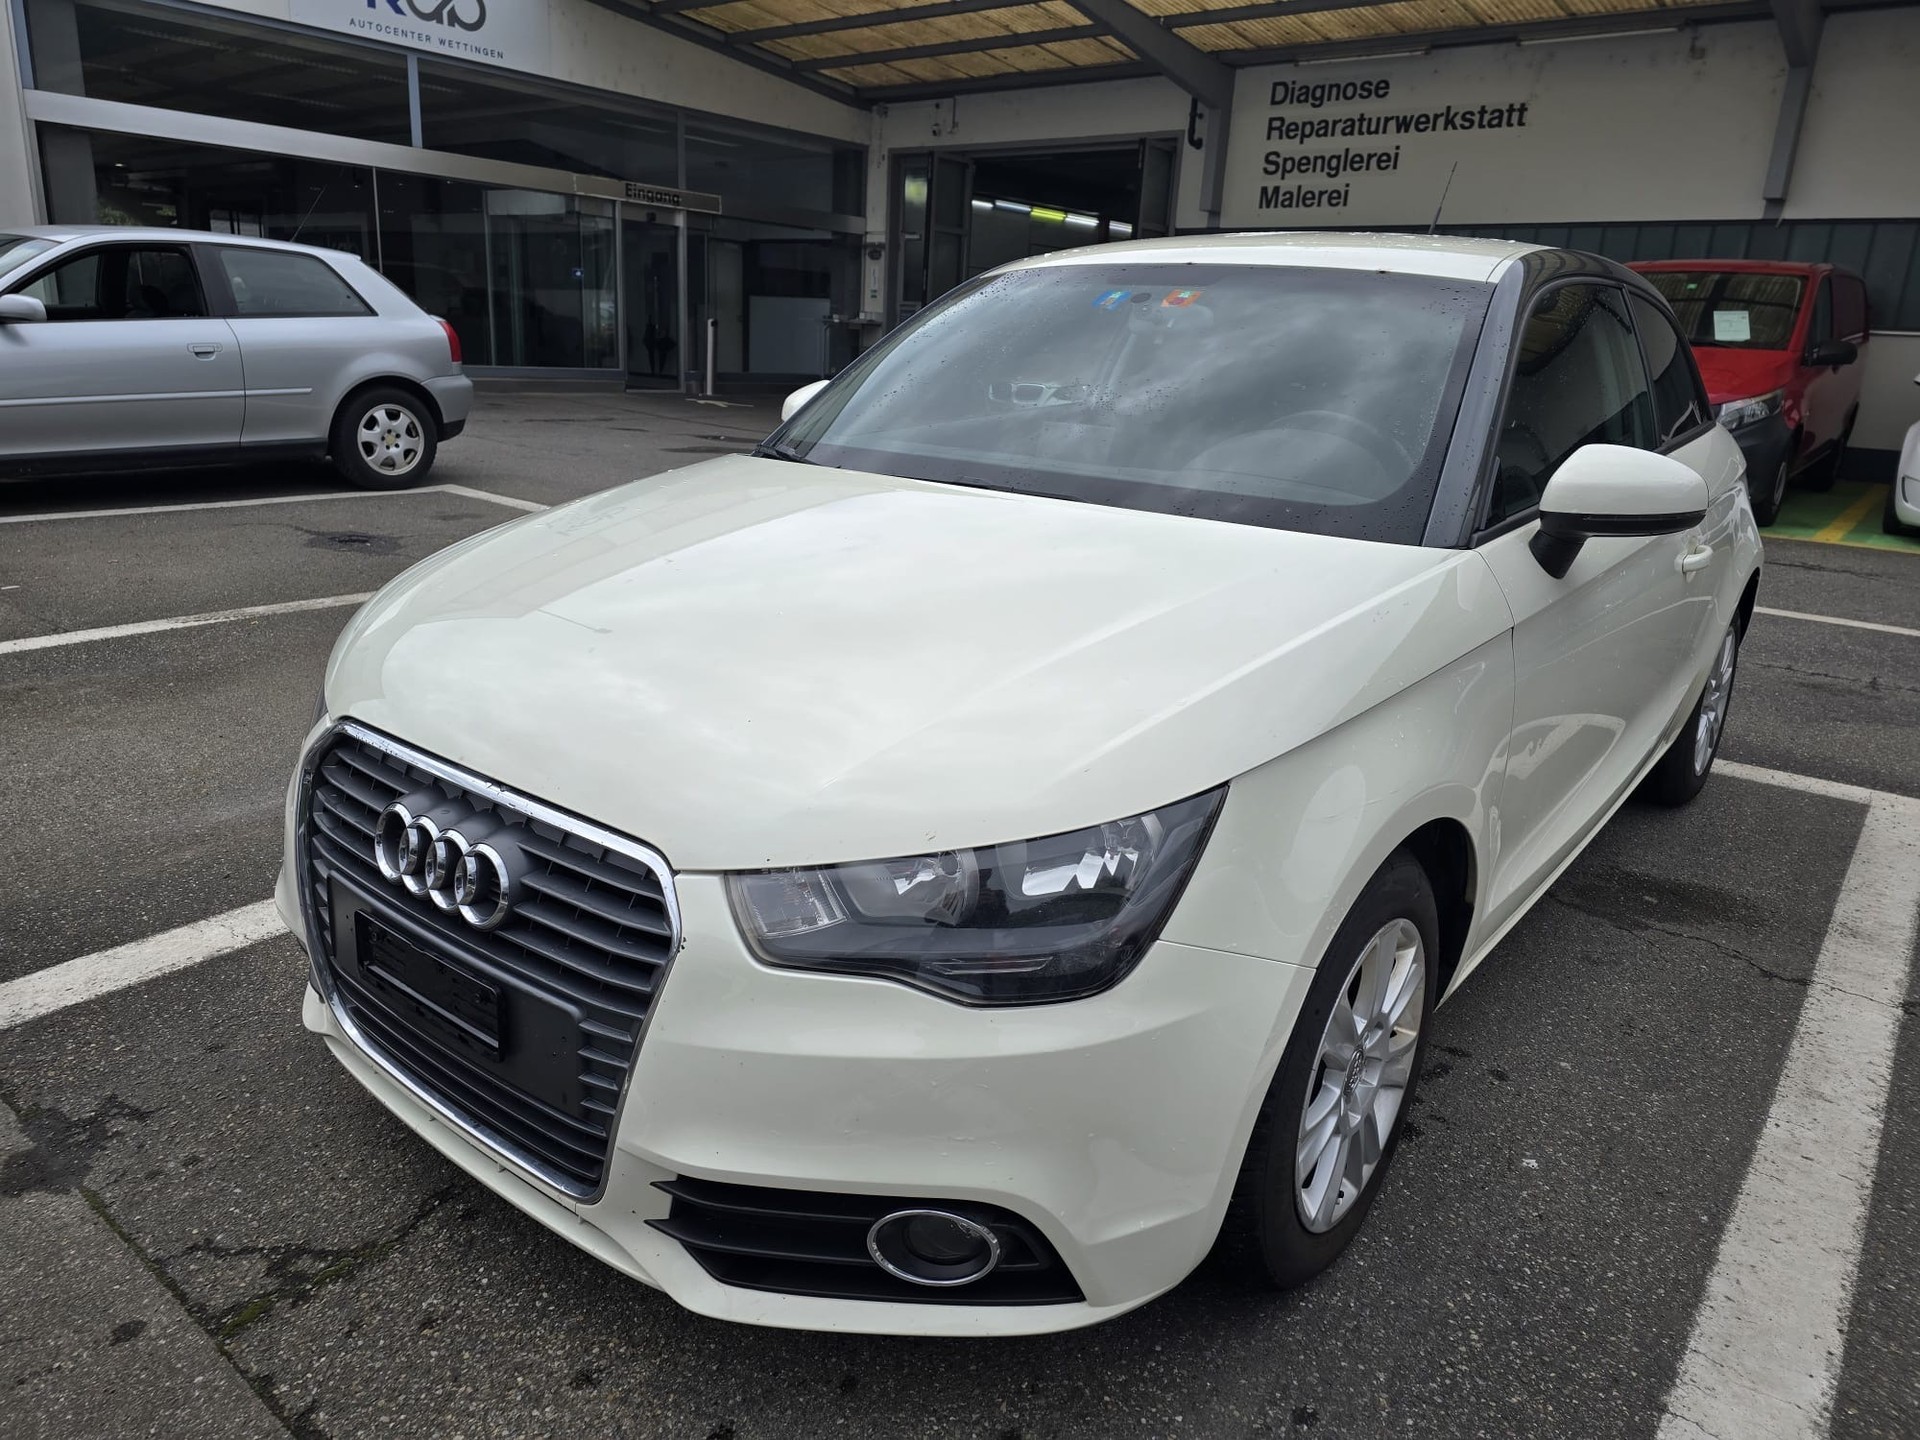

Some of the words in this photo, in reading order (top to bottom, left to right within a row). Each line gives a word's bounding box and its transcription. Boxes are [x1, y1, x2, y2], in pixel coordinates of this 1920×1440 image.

[349, 17, 432, 43] AUTOCENTER
[438, 37, 504, 60] WETTINGEN
[1270, 79, 1390, 108] Diagnose
[1266, 102, 1528, 144] Reparaturwerkstatt
[1262, 146, 1400, 180] Spenglerei
[625, 182, 680, 206] Eingang
[1258, 183, 1350, 209] Malerei
